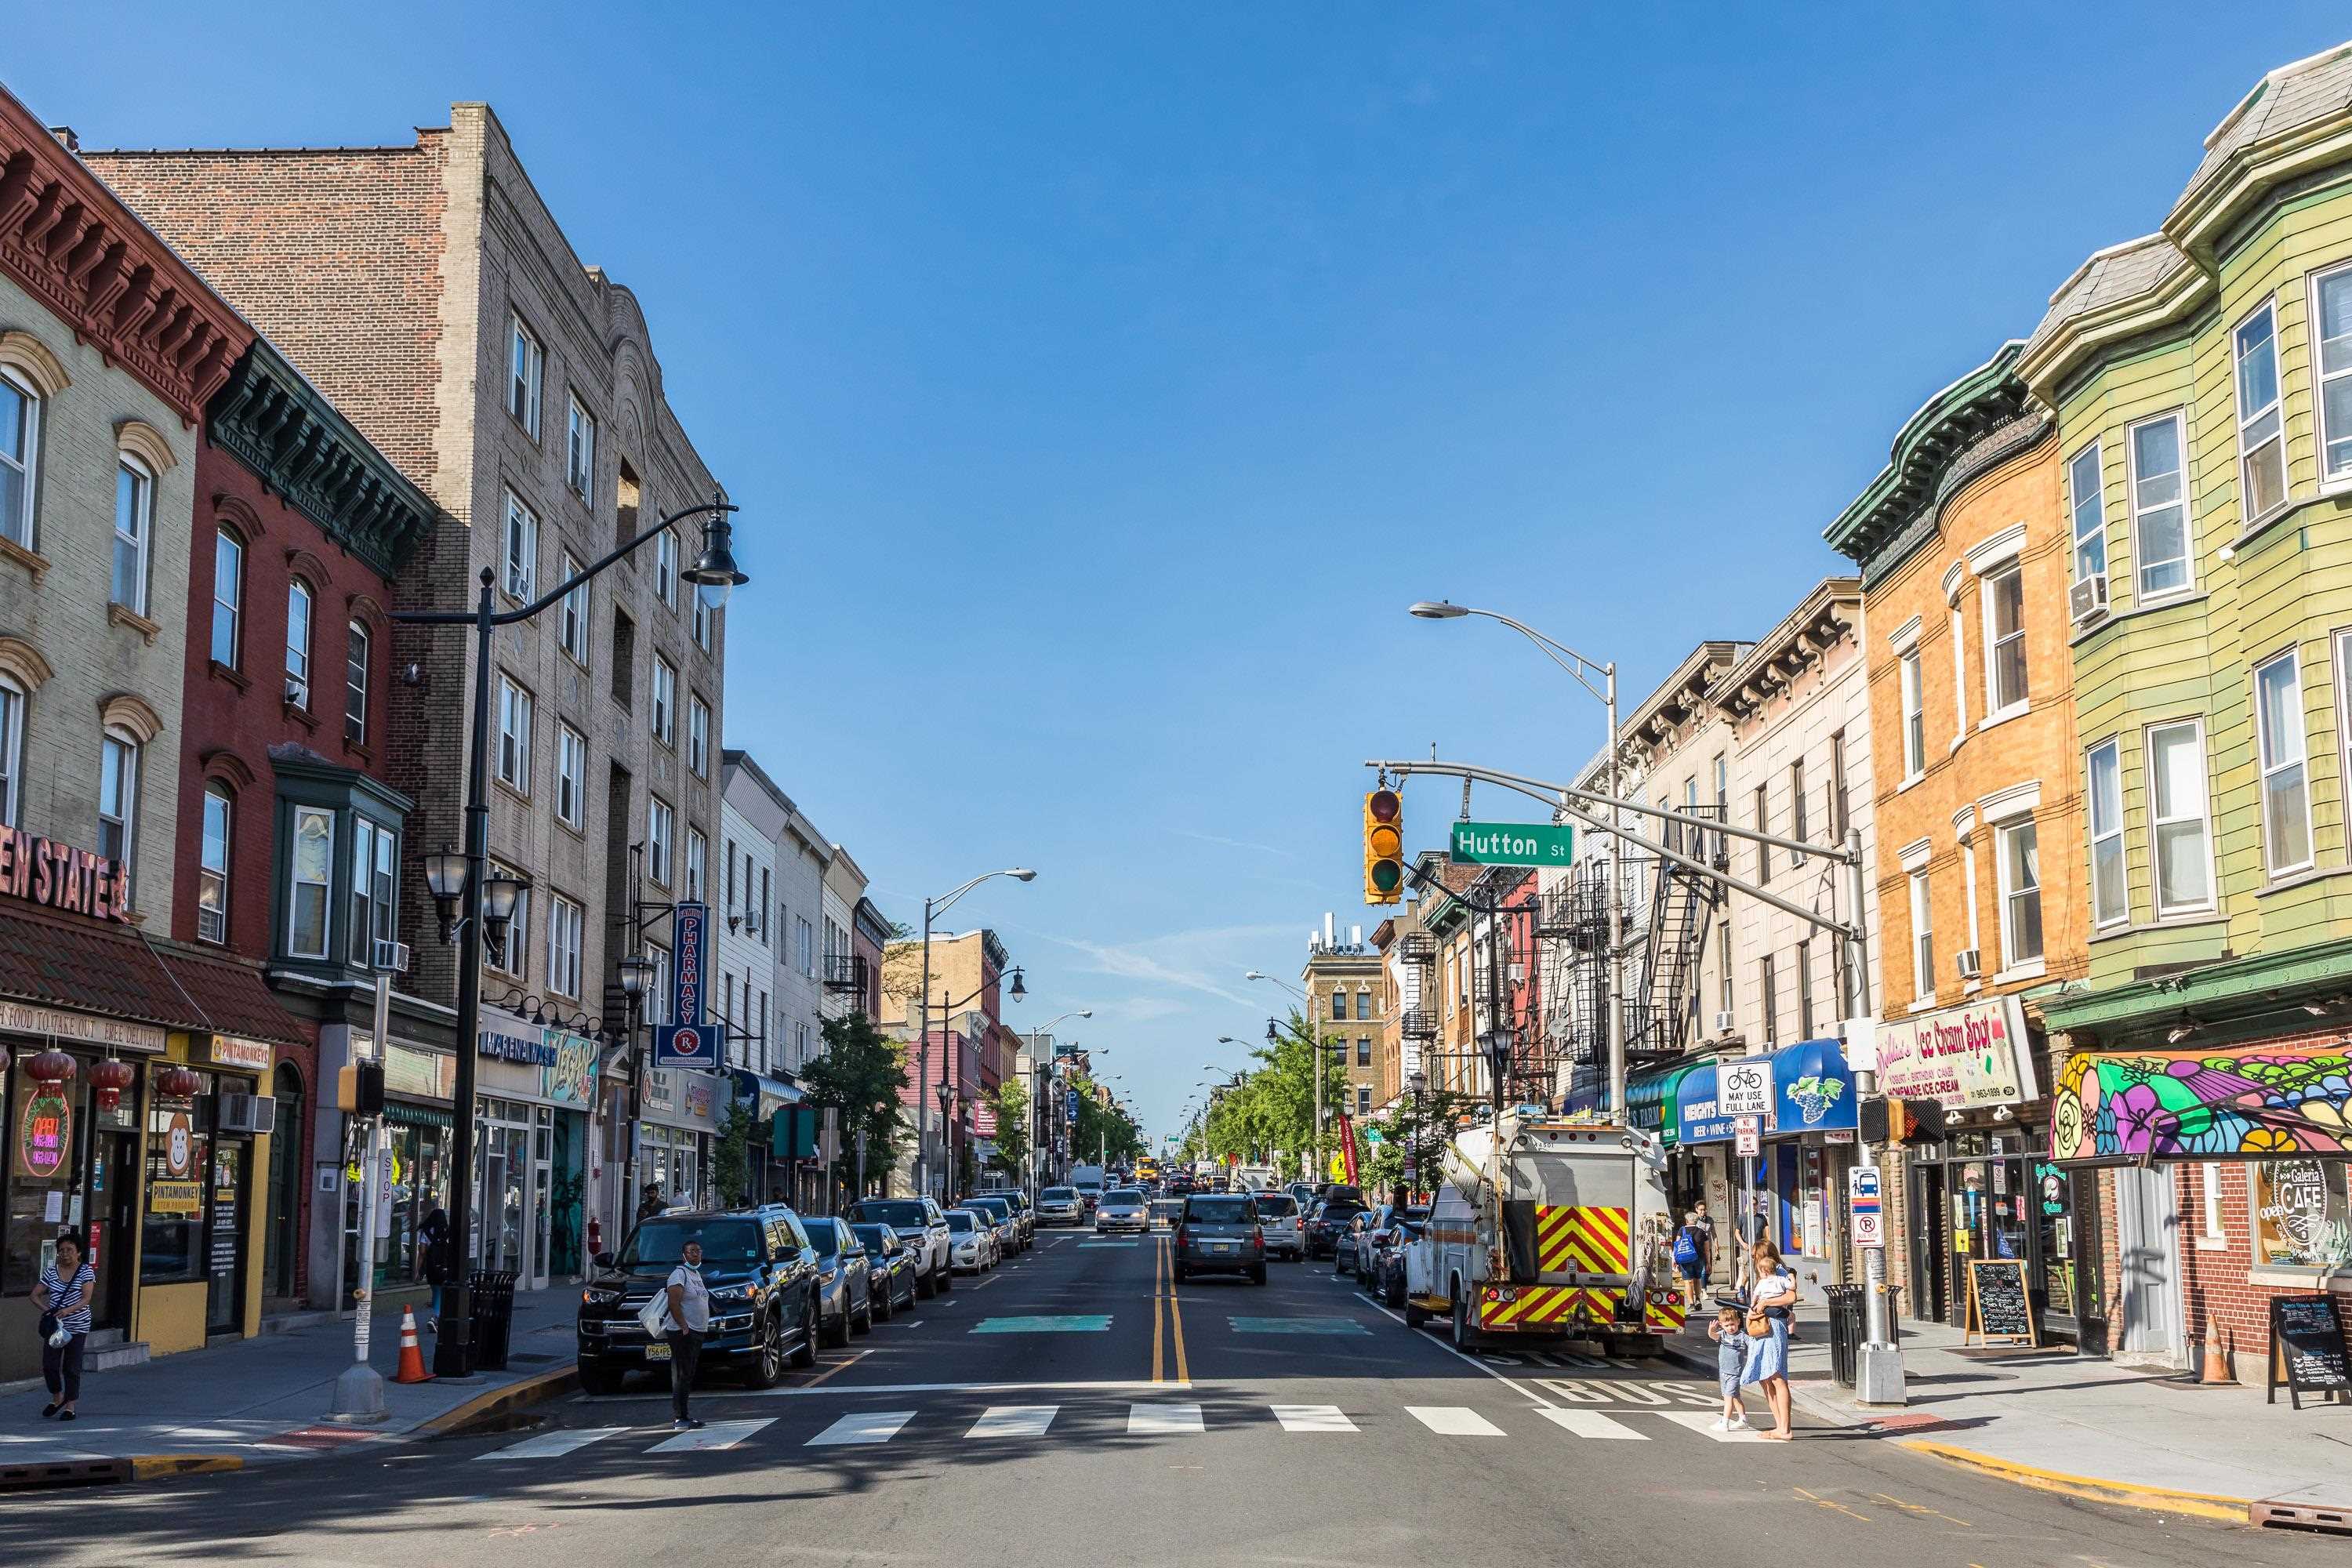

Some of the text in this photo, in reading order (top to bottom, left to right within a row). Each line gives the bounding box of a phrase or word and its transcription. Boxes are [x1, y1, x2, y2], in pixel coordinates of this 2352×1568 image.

[1459, 831, 1565, 856] Hutton St
[34, 835, 109, 919] STATE
[677, 908, 702, 920] FAMILY
[681, 918, 698, 1025] PHARMACY
[9, 1007, 33, 1029] FOOD
[38, 1011, 49, 1032] TO
[79, 1019, 95, 1038] OUT
[104, 1022, 123, 1042] FREE
[126, 1025, 163, 1048] DELIVERY
[1934, 1021, 1966, 1057] Cream
[1965, 1013, 1992, 1059] Spot
[1729, 1091, 1762, 1102] MAY USE
[1887, 1083, 1922, 1097] HOMEMADE
[1922, 1083, 1935, 1095] ICE
[1934, 1079, 1960, 1094] CREAM
[1640, 1105, 1660, 1127] FARM
[1684, 1100, 1717, 1122] HEIGHTS
[1726, 1102, 1766, 1112] FULL LANE
[1693, 1126, 1706, 1137] BEER
[1710, 1123, 1726, 1135] WINE
[383, 1157, 391, 1203] STOP
[2291, 1167, 2320, 1183] Galeria
[154, 1185, 199, 1200] PINTAMONKEY
[2281, 1182, 2321, 1214] CAFE
[1530, 1378, 1725, 1407] BUS
